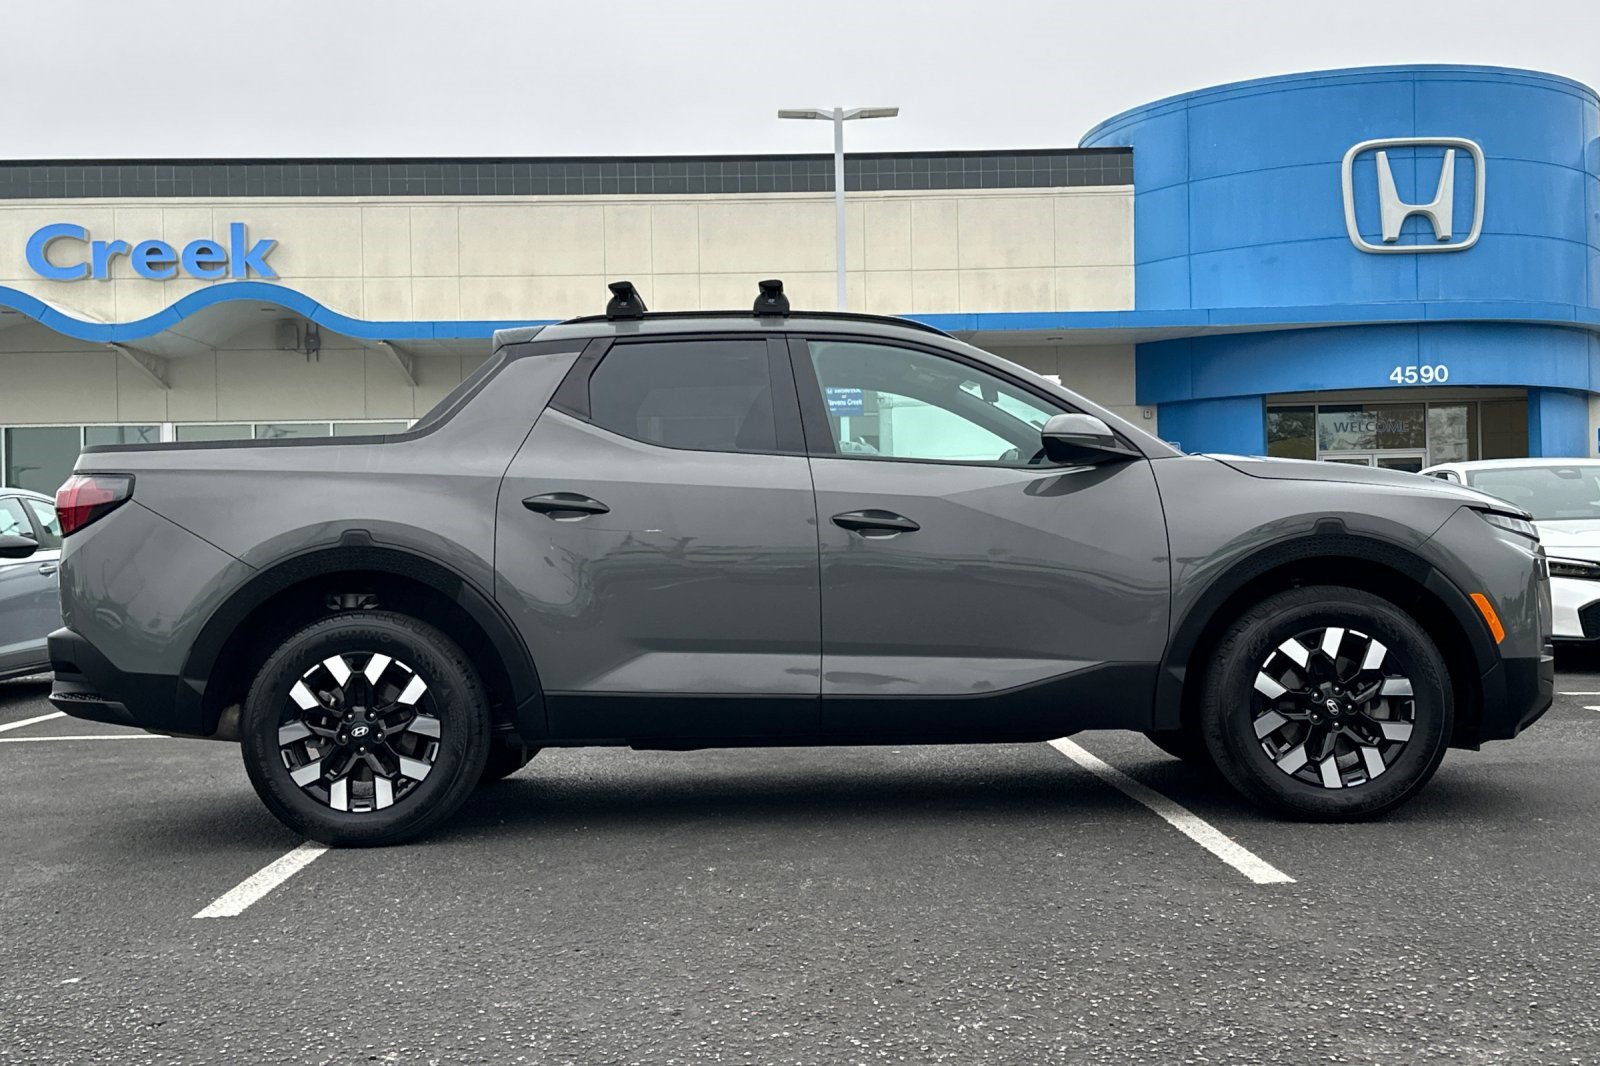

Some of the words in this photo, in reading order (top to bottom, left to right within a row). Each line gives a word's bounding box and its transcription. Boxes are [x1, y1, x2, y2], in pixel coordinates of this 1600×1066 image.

[25, 222, 279, 281] Creek
[1389, 364, 1449, 384] 4590
[1333, 421, 1410, 433] WELCOME
